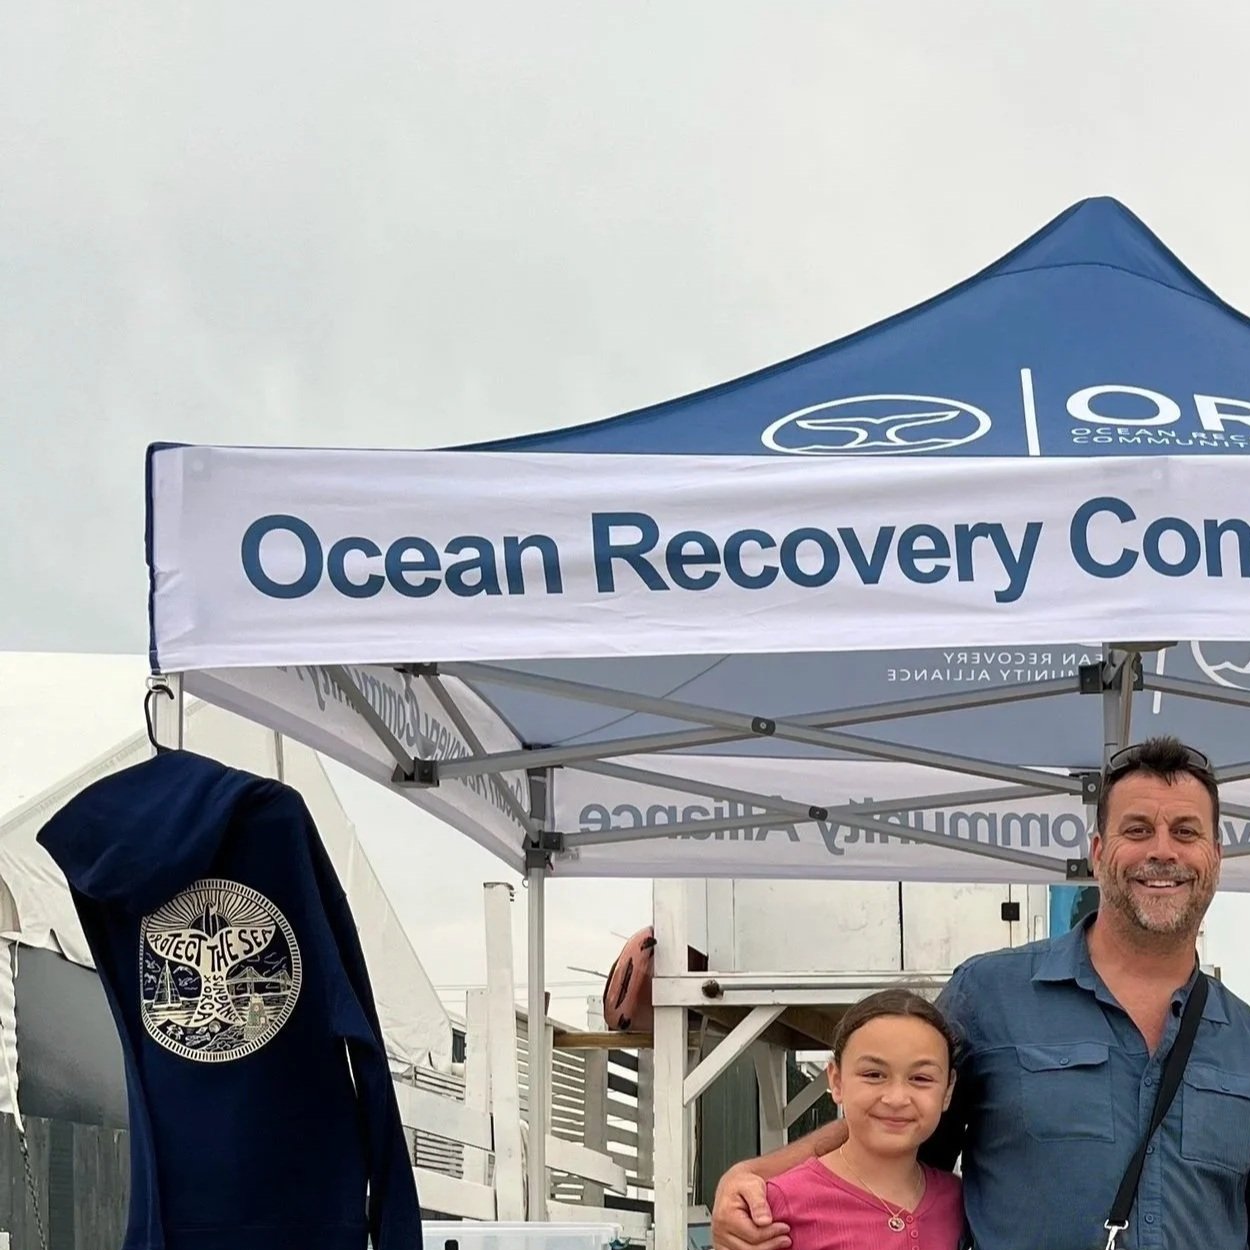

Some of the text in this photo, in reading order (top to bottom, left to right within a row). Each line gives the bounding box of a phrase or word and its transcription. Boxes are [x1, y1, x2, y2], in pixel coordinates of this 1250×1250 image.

[1071, 426, 1177, 438] OCEAN
[240, 513, 564, 599] Ocean
[590, 511, 1044, 604] Recovery
[149, 928, 273, 972] PROTECT THE SEA
[194, 986, 214, 1023] ORCA
